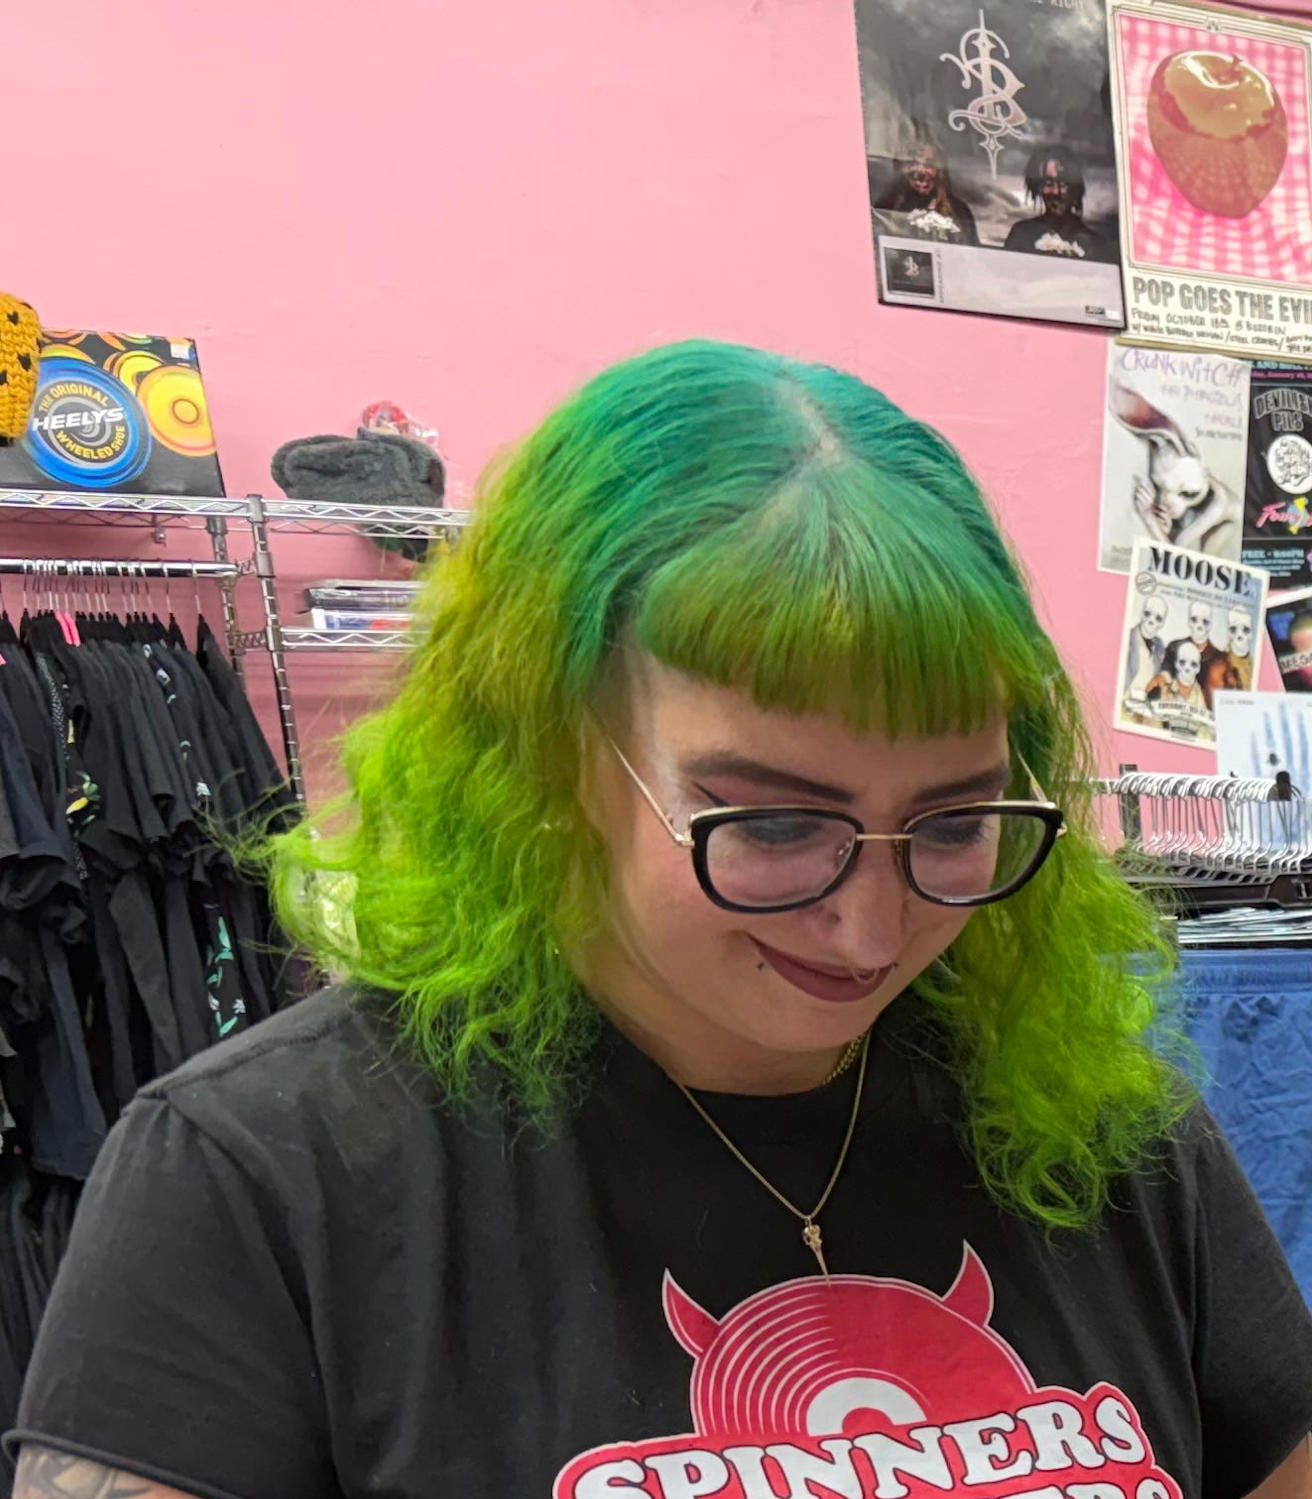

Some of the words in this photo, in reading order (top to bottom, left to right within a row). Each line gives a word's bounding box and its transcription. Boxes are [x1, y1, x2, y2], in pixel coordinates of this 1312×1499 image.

[1133, 277, 1175, 307] POP
[1179, 283, 1233, 316] GOES
[1235, 289, 1274, 321] THE
[51, 383, 110, 408] ORIGINAL
[31, 406, 125, 432] HEELYS
[56, 430, 115, 461] WHEELED
[112, 425, 126, 452] SHOE
[1147, 546, 1252, 597] MOOSE
